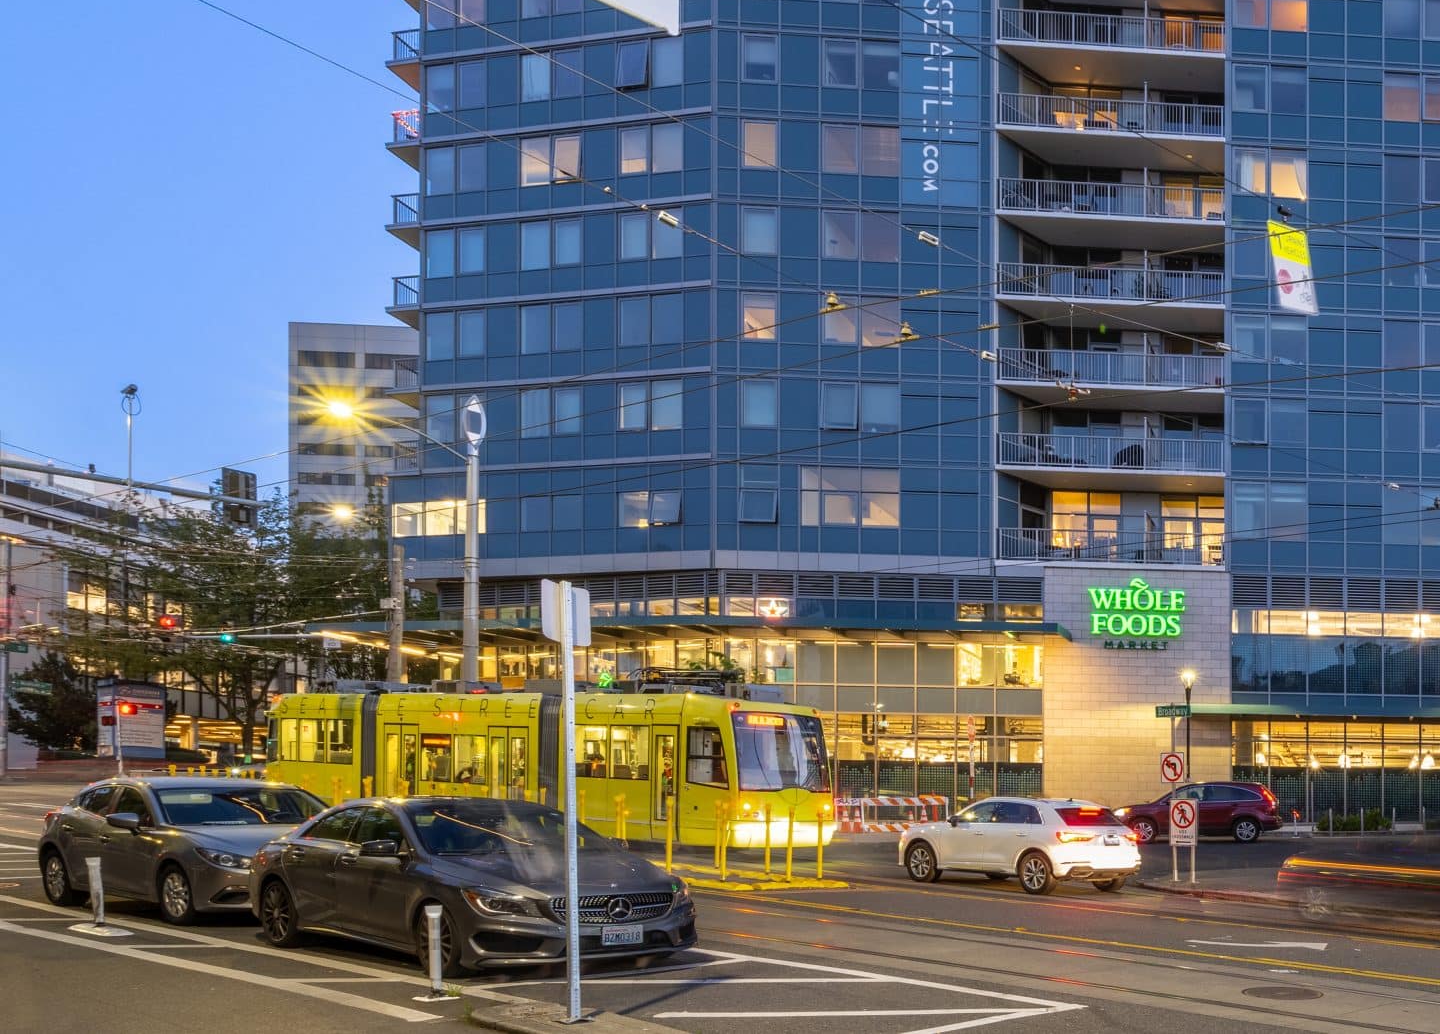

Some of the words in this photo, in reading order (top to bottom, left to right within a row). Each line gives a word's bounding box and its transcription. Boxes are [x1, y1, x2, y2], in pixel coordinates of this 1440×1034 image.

[1087, 577, 1186, 612] WHOLE
[1090, 613, 1181, 637] FOODS
[1104, 640, 1168, 650] MARKET
[433, 697, 656, 719] STREECAR
